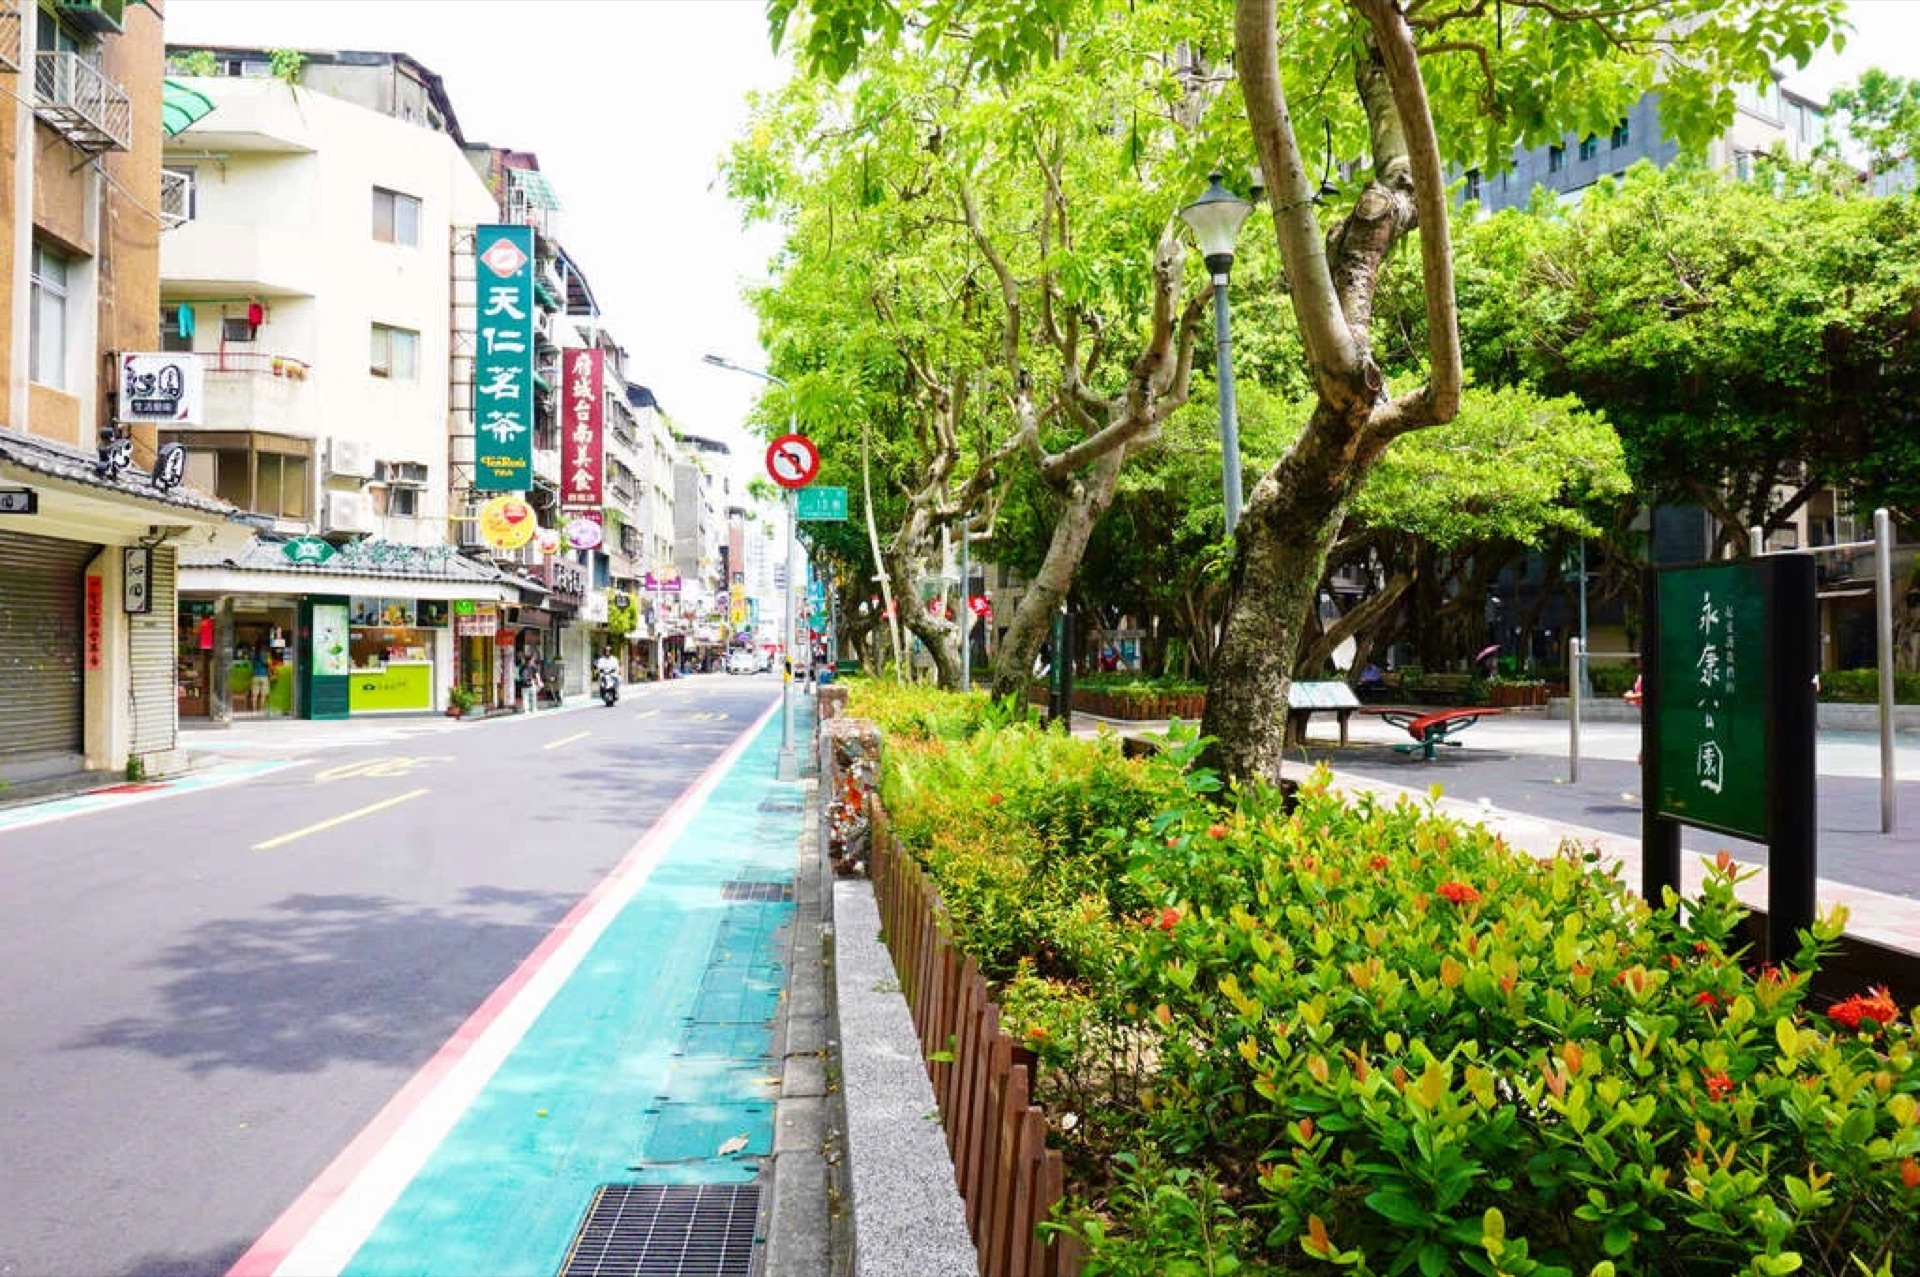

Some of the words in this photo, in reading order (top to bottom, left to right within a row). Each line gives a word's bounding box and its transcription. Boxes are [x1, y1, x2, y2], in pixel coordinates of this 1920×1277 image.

[480, 286, 526, 443] 天仁茗茶
[571, 352, 595, 492] 府城台南美食
[1696, 590, 1723, 794] 永康公園
